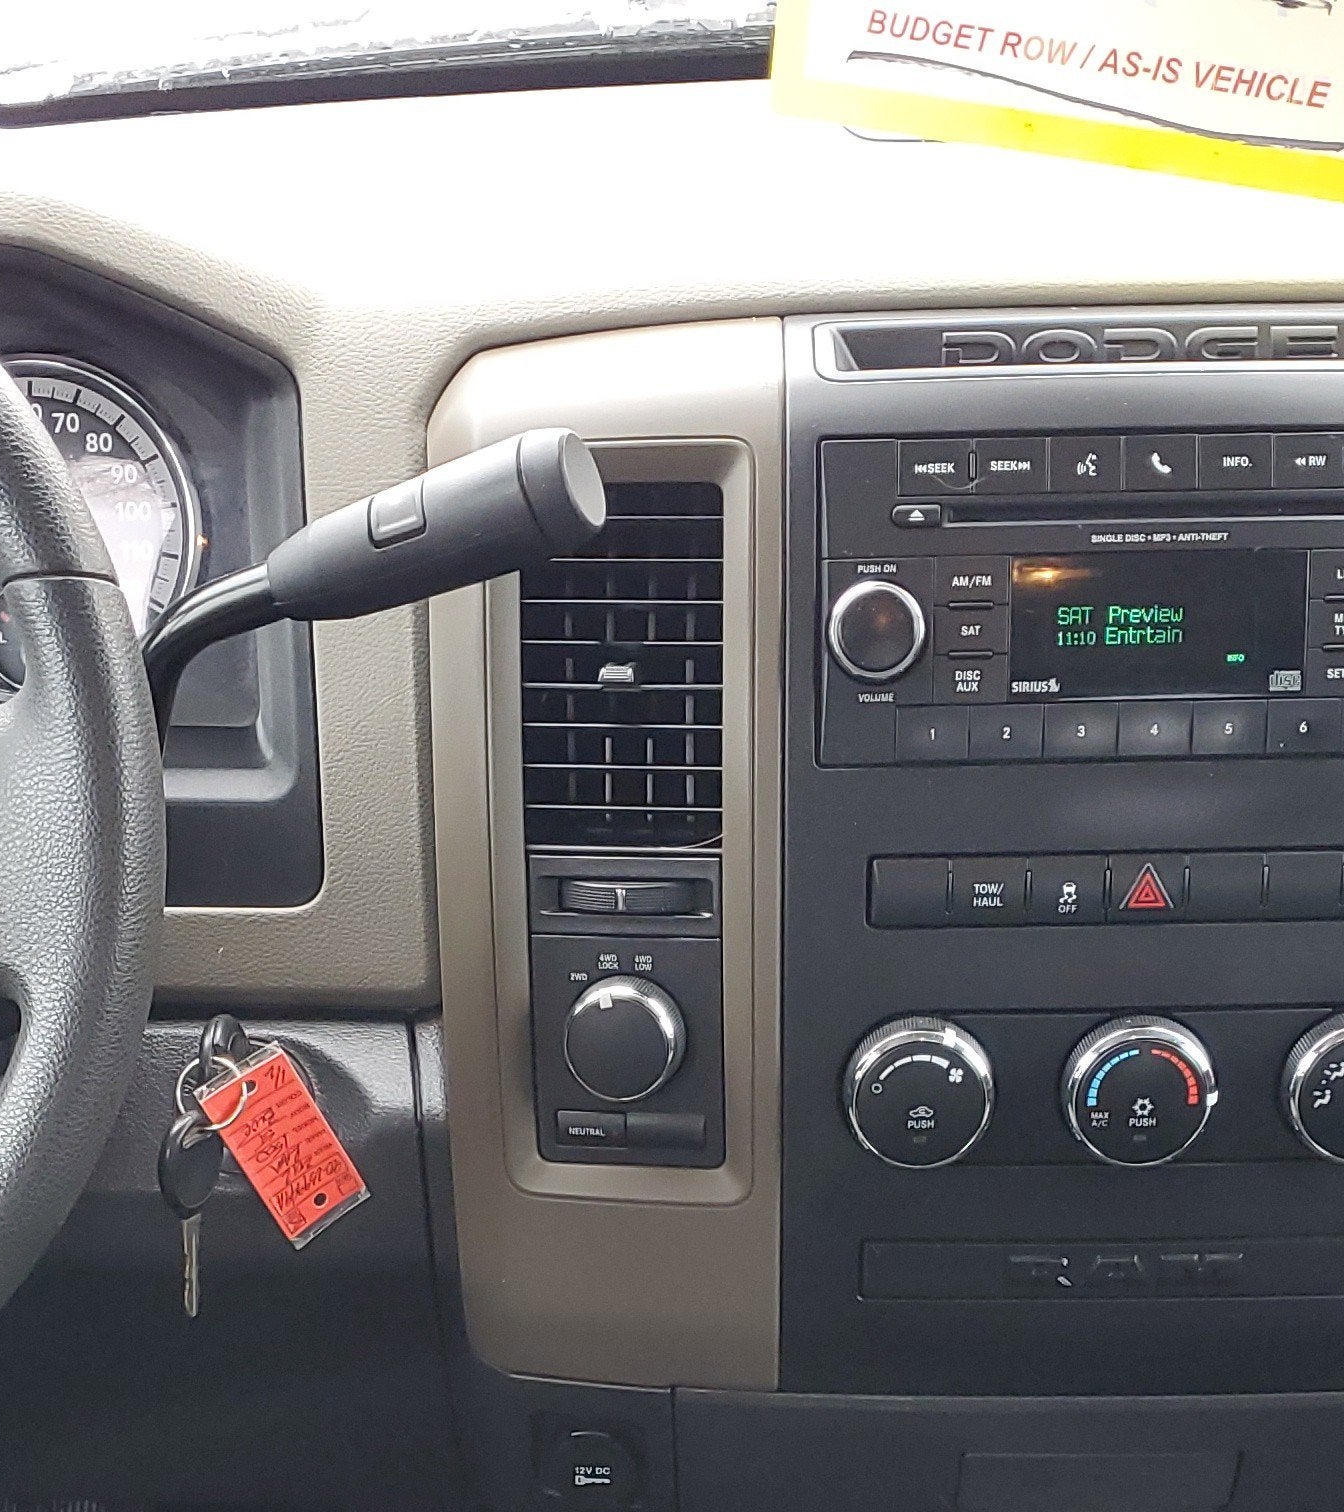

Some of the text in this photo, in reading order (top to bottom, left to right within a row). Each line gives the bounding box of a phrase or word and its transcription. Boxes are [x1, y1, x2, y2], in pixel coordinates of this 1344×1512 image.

[867, 9, 994, 54] BUDGET
[1000, 33, 1078, 69] ROW
[1098, 47, 1181, 86] AS-IS
[1192, 61, 1331, 110] VEHICLE
[942, 325, 1340, 367] DODGE
[51, 412, 80, 433] 70
[85, 432, 113, 453] 80
[990, 460, 1018, 471] SEEK
[1308, 455, 1327, 467] RW
[110, 463, 138, 484] 90
[928, 463, 955, 474] SEEK
[113, 501, 152, 521] 100
[1090, 534, 1124, 543] SINGLE
[1125, 533, 1146, 542] DISC
[857, 564, 882, 574] PUSH
[952, 575, 992, 588] AM/FM
[1058, 604, 1184, 626] SAT Preview
[961, 624, 981, 636] SAT
[1057, 626, 1183, 646] 11:10 Entrtain
[0, 631, 8, 644] L
[955, 670, 981, 681] DISC
[956, 681, 979, 693] AUX
[1011, 681, 1048, 692] SIRIUS
[858, 692, 895, 703] VOLUME
[1002, 727, 1011, 739] 2
[1077, 725, 1085, 737] 3
[1150, 724, 1159, 736] 4
[1224, 723, 1233, 735] 5
[1299, 721, 1308, 733] 6
[929, 729, 936, 740] 1
[972, 883, 1004, 896] TOW/
[972, 895, 1003, 908] HAUL
[1058, 903, 1078, 914] OFF
[634, 963, 652, 971] LOW
[907, 1120, 935, 1130] PUSH
[1129, 1118, 1156, 1127] PUSH
[569, 1126, 606, 1137] NEUTRAL
